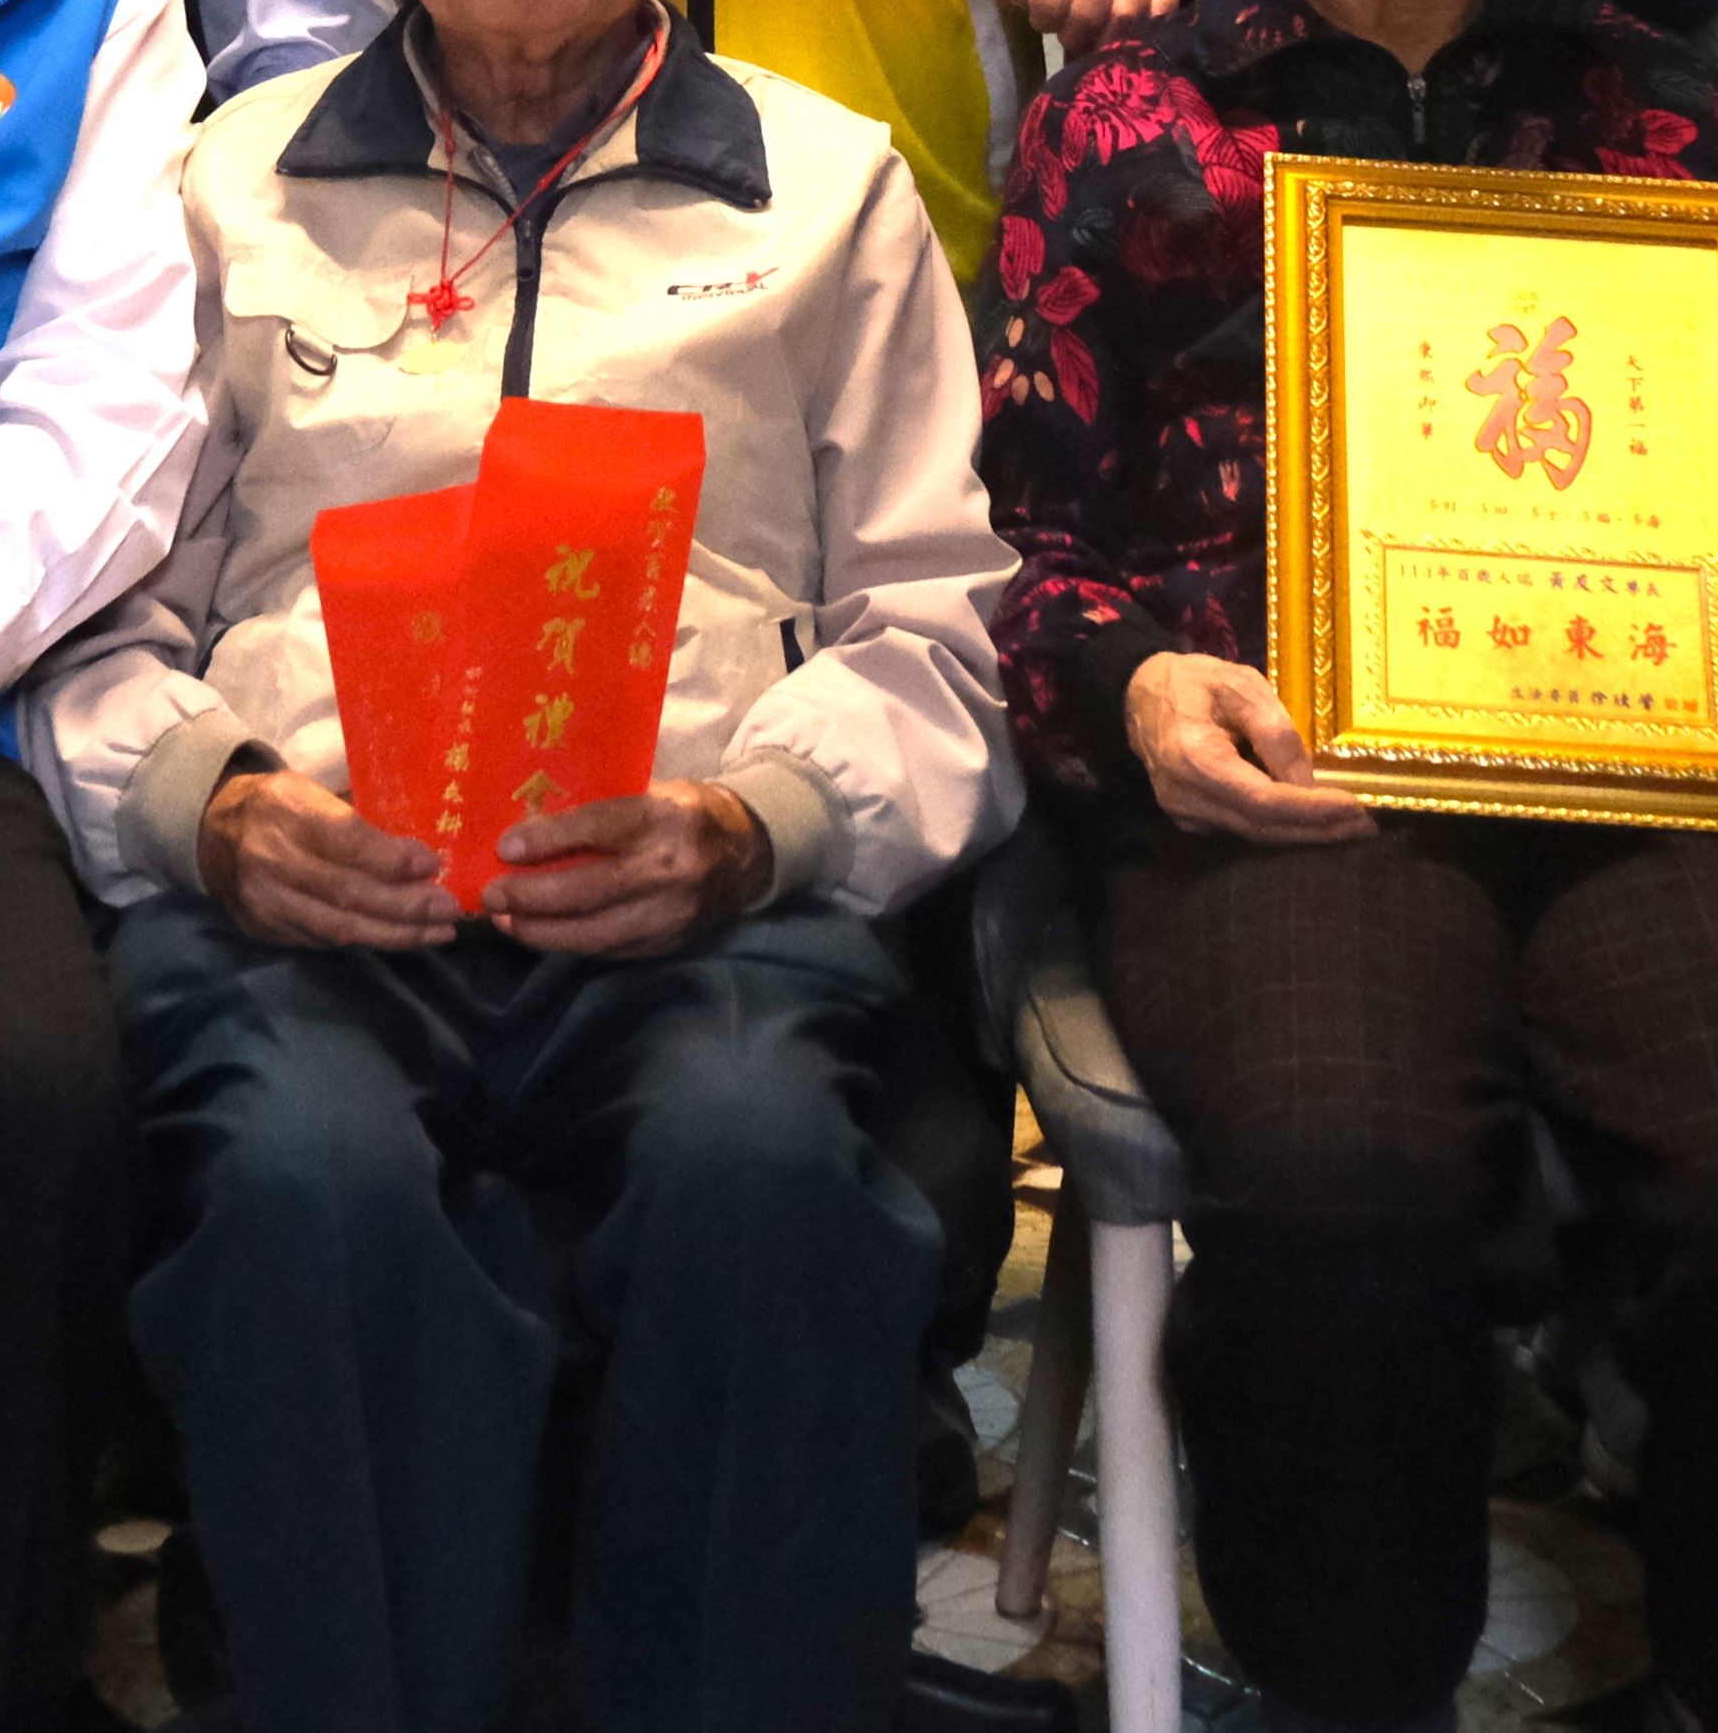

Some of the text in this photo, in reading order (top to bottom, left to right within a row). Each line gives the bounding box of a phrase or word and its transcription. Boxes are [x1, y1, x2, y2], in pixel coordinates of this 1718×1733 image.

[1464, 316, 1593, 492] 福
[1416, 605, 1678, 667] 福如東海
